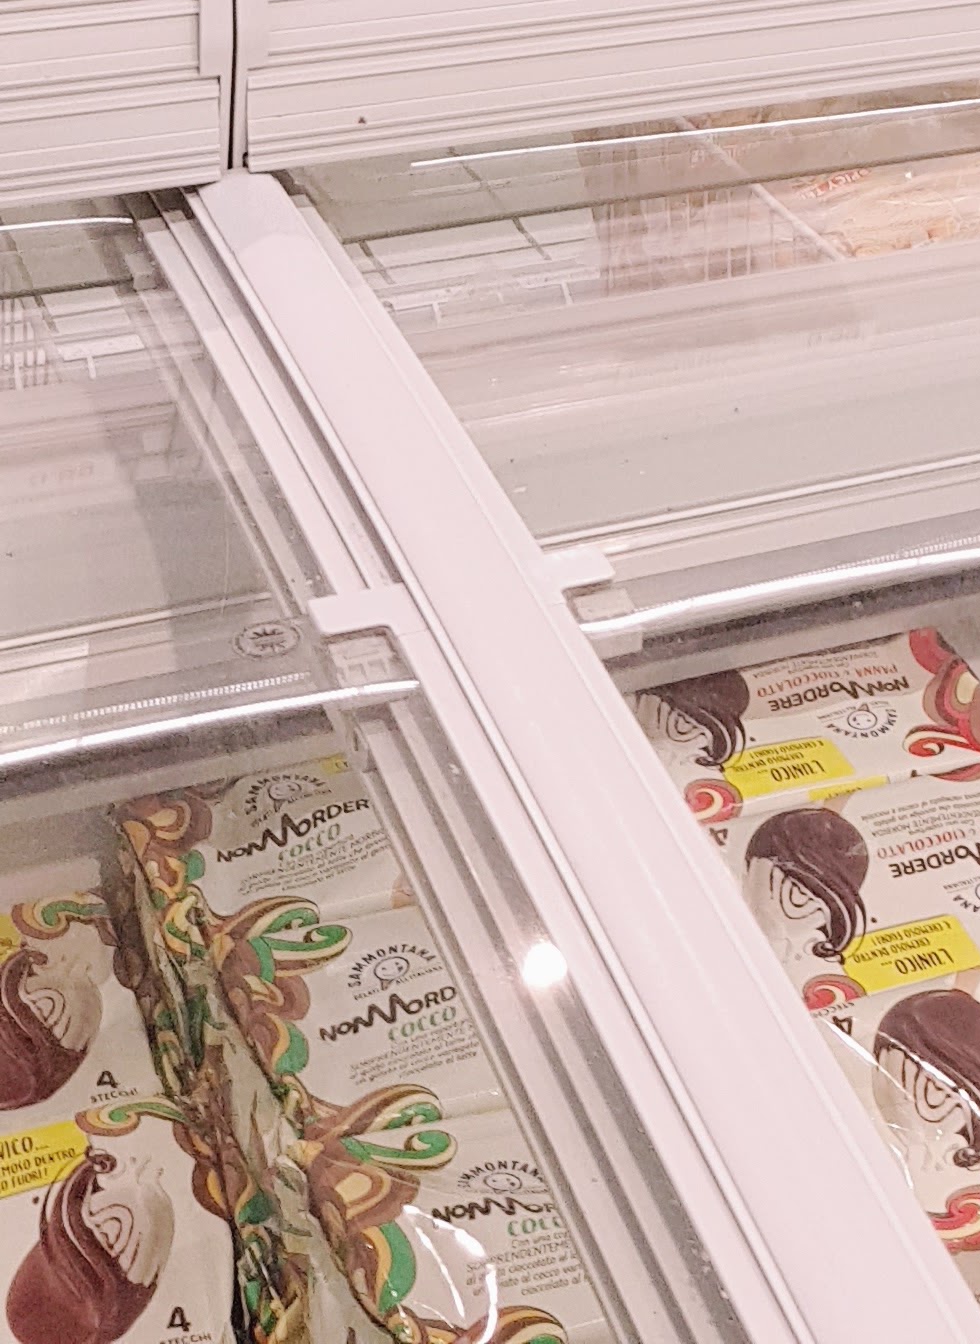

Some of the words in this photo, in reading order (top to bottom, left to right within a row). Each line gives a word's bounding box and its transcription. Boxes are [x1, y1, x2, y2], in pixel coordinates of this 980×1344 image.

[855, 664, 899, 677] PANNA
[757, 671, 839, 697] CIOCCOLATO
[279, 823, 341, 861] COCCO
[709, 827, 729, 847] 4
[877, 829, 966, 859] CIOCCOLATO
[348, 943, 436, 988] SAMMONTANA
[388, 1006, 456, 1041] COCCO
[832, 1015, 854, 1036] 4
[97, 1071, 118, 1089] 4
[167, 1307, 190, 1332] 4
